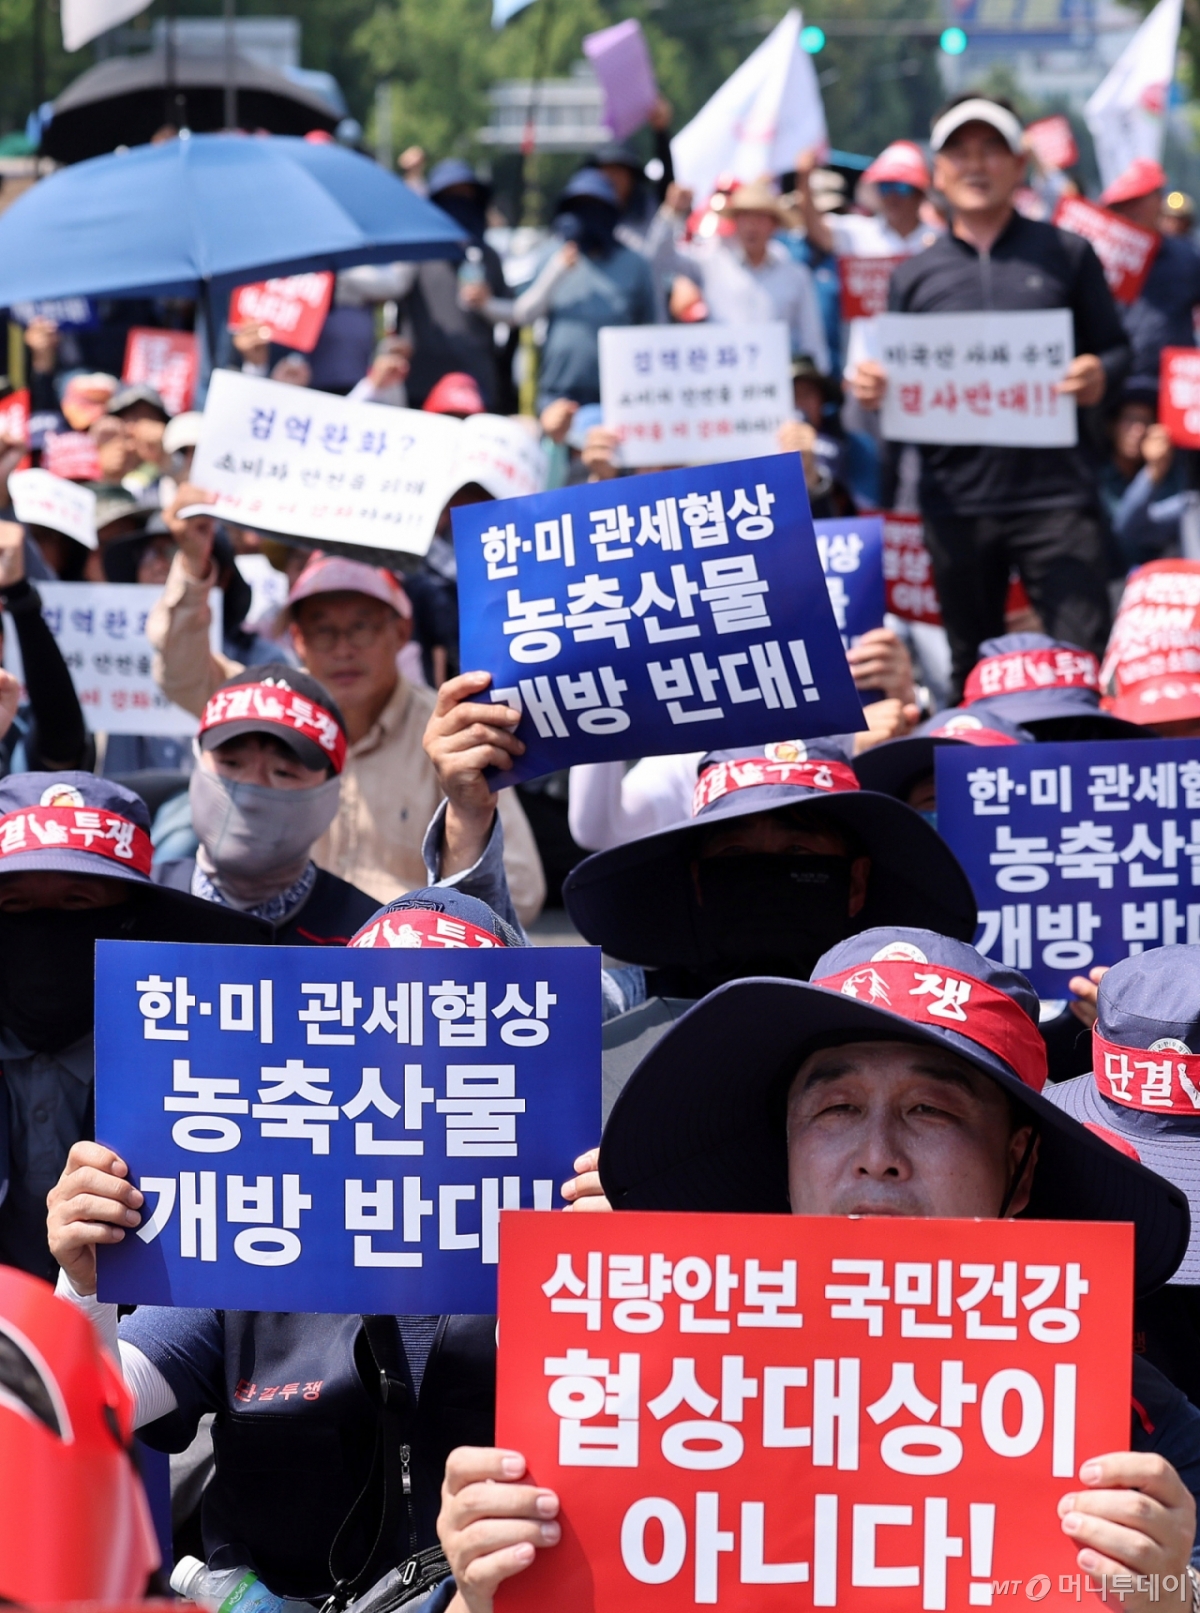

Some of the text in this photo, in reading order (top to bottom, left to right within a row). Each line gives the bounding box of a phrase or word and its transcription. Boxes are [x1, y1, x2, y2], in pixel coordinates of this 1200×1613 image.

[213, 449, 289, 482] 소비자
[249, 406, 416, 459] 검역완화?
[480, 483, 775, 580] 한·미 관세협상
[816, 532, 864, 573] 상
[503, 554, 772, 664] 농축산물
[490, 639, 820, 739] 개방 반대!
[980, 655, 1027, 694] 단결
[205, 688, 339, 751] 단결 투쟁
[967, 765, 1072, 816] 한·미
[70, 811, 136, 859] 투쟁
[989, 819, 1200, 893] 농축산
[975, 898, 1200, 970] 개방 반
[135, 974, 557, 1048] 한·미 관세협상
[908, 972, 972, 1022] 쟁
[163, 1059, 526, 1157] 농축산물
[1104, 1051, 1174, 1107] 단결
[135, 1171, 312, 1266] 개방
[541, 1251, 1089, 1344] 식량안보 국민건강
[234, 1378, 323, 1402] 단결투쟁
[543, 1348, 1076, 1479] 협상대상이
[620, 1491, 996, 1610] 아니다!
